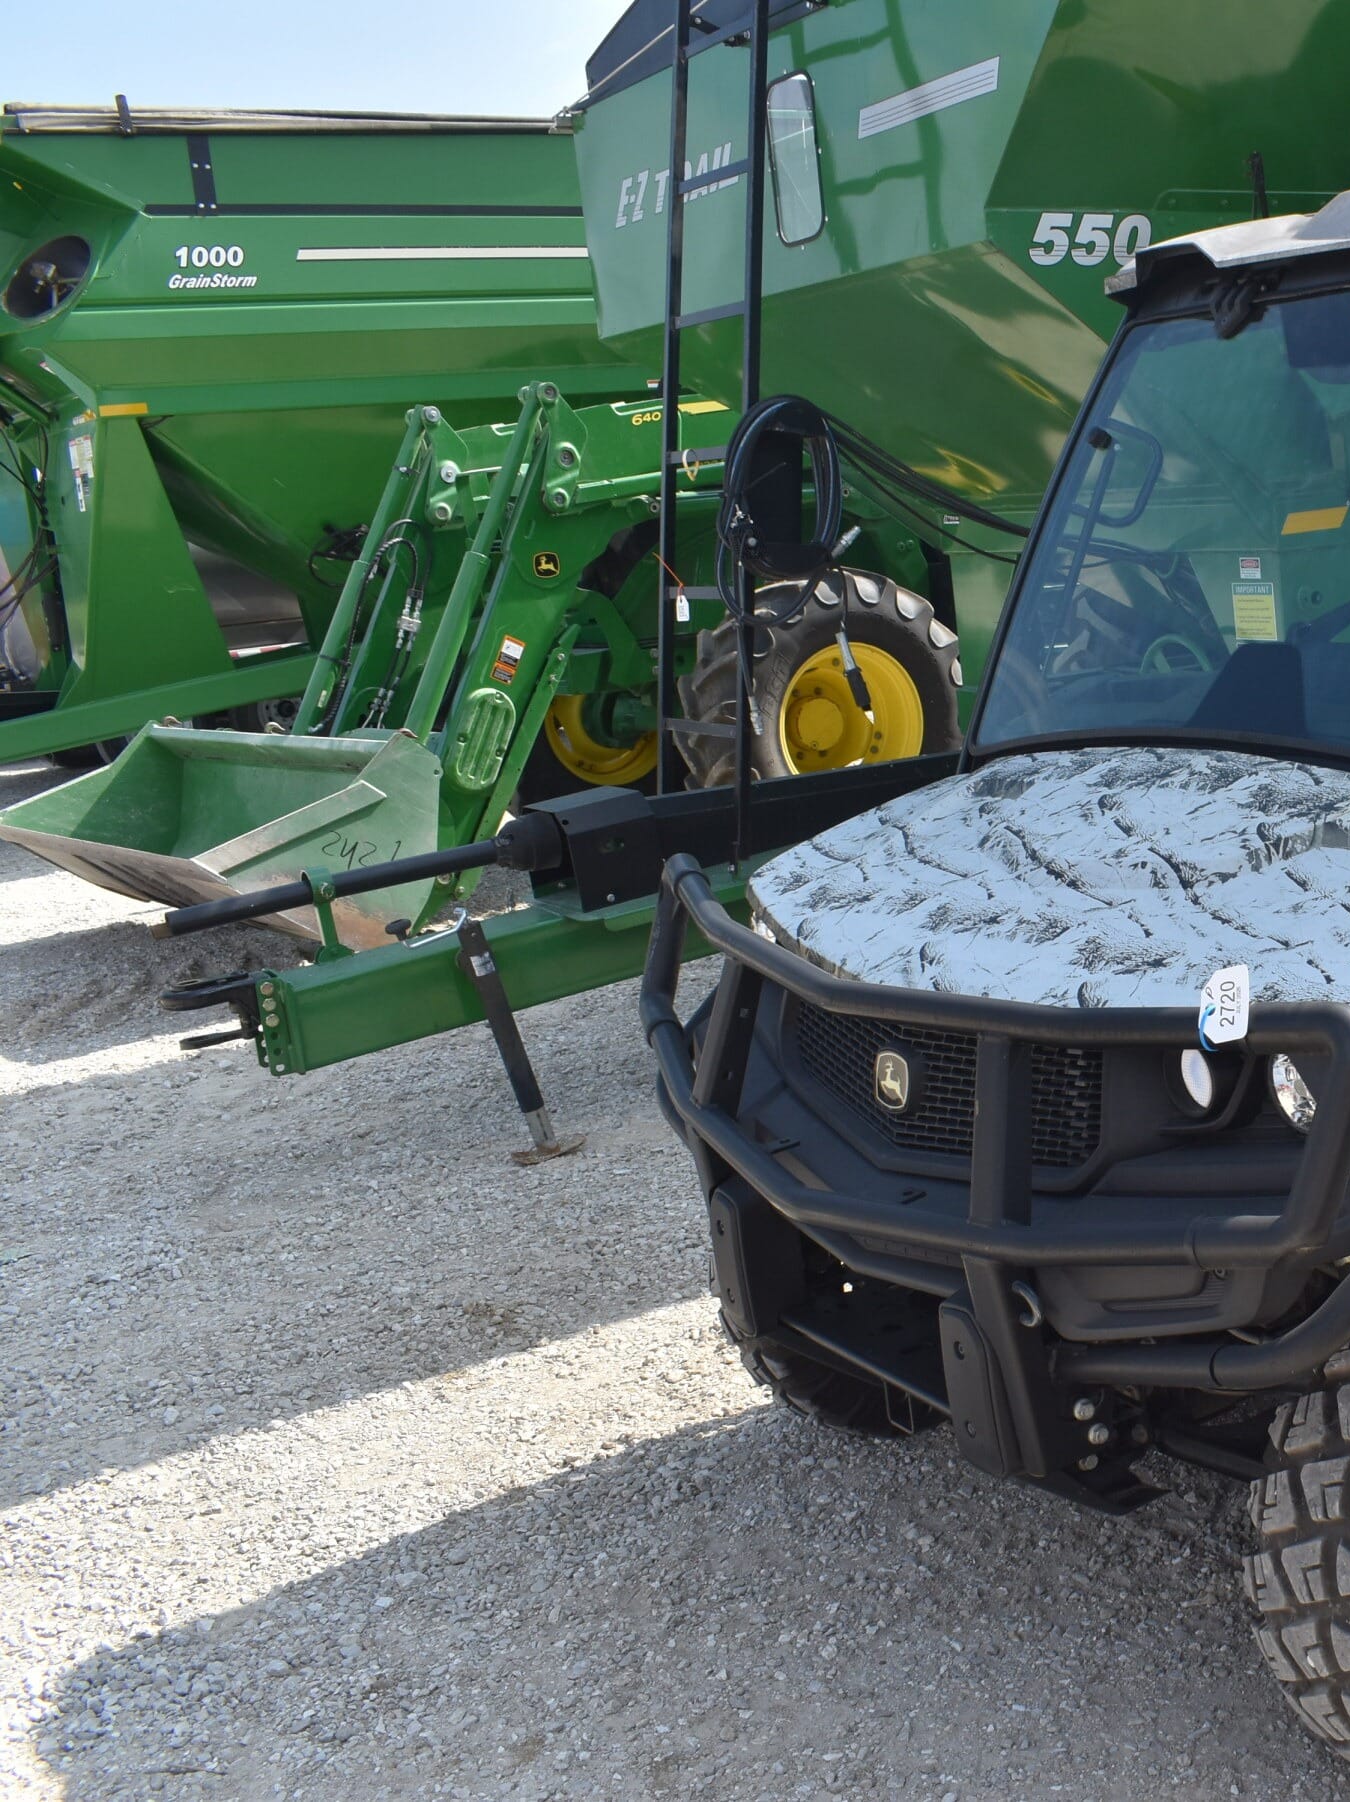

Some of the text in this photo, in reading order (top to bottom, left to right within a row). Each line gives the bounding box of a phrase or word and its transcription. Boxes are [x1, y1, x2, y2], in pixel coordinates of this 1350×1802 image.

[615, 170, 649, 228] E-Z
[1029, 212, 1152, 266] 550
[175, 246, 244, 268] 1000
[168, 273, 258, 289] GrainStorm
[632, 411, 662, 426] 640
[1235, 585, 1270, 594] IMPORTANT
[1219, 981, 1236, 1028] 2720
